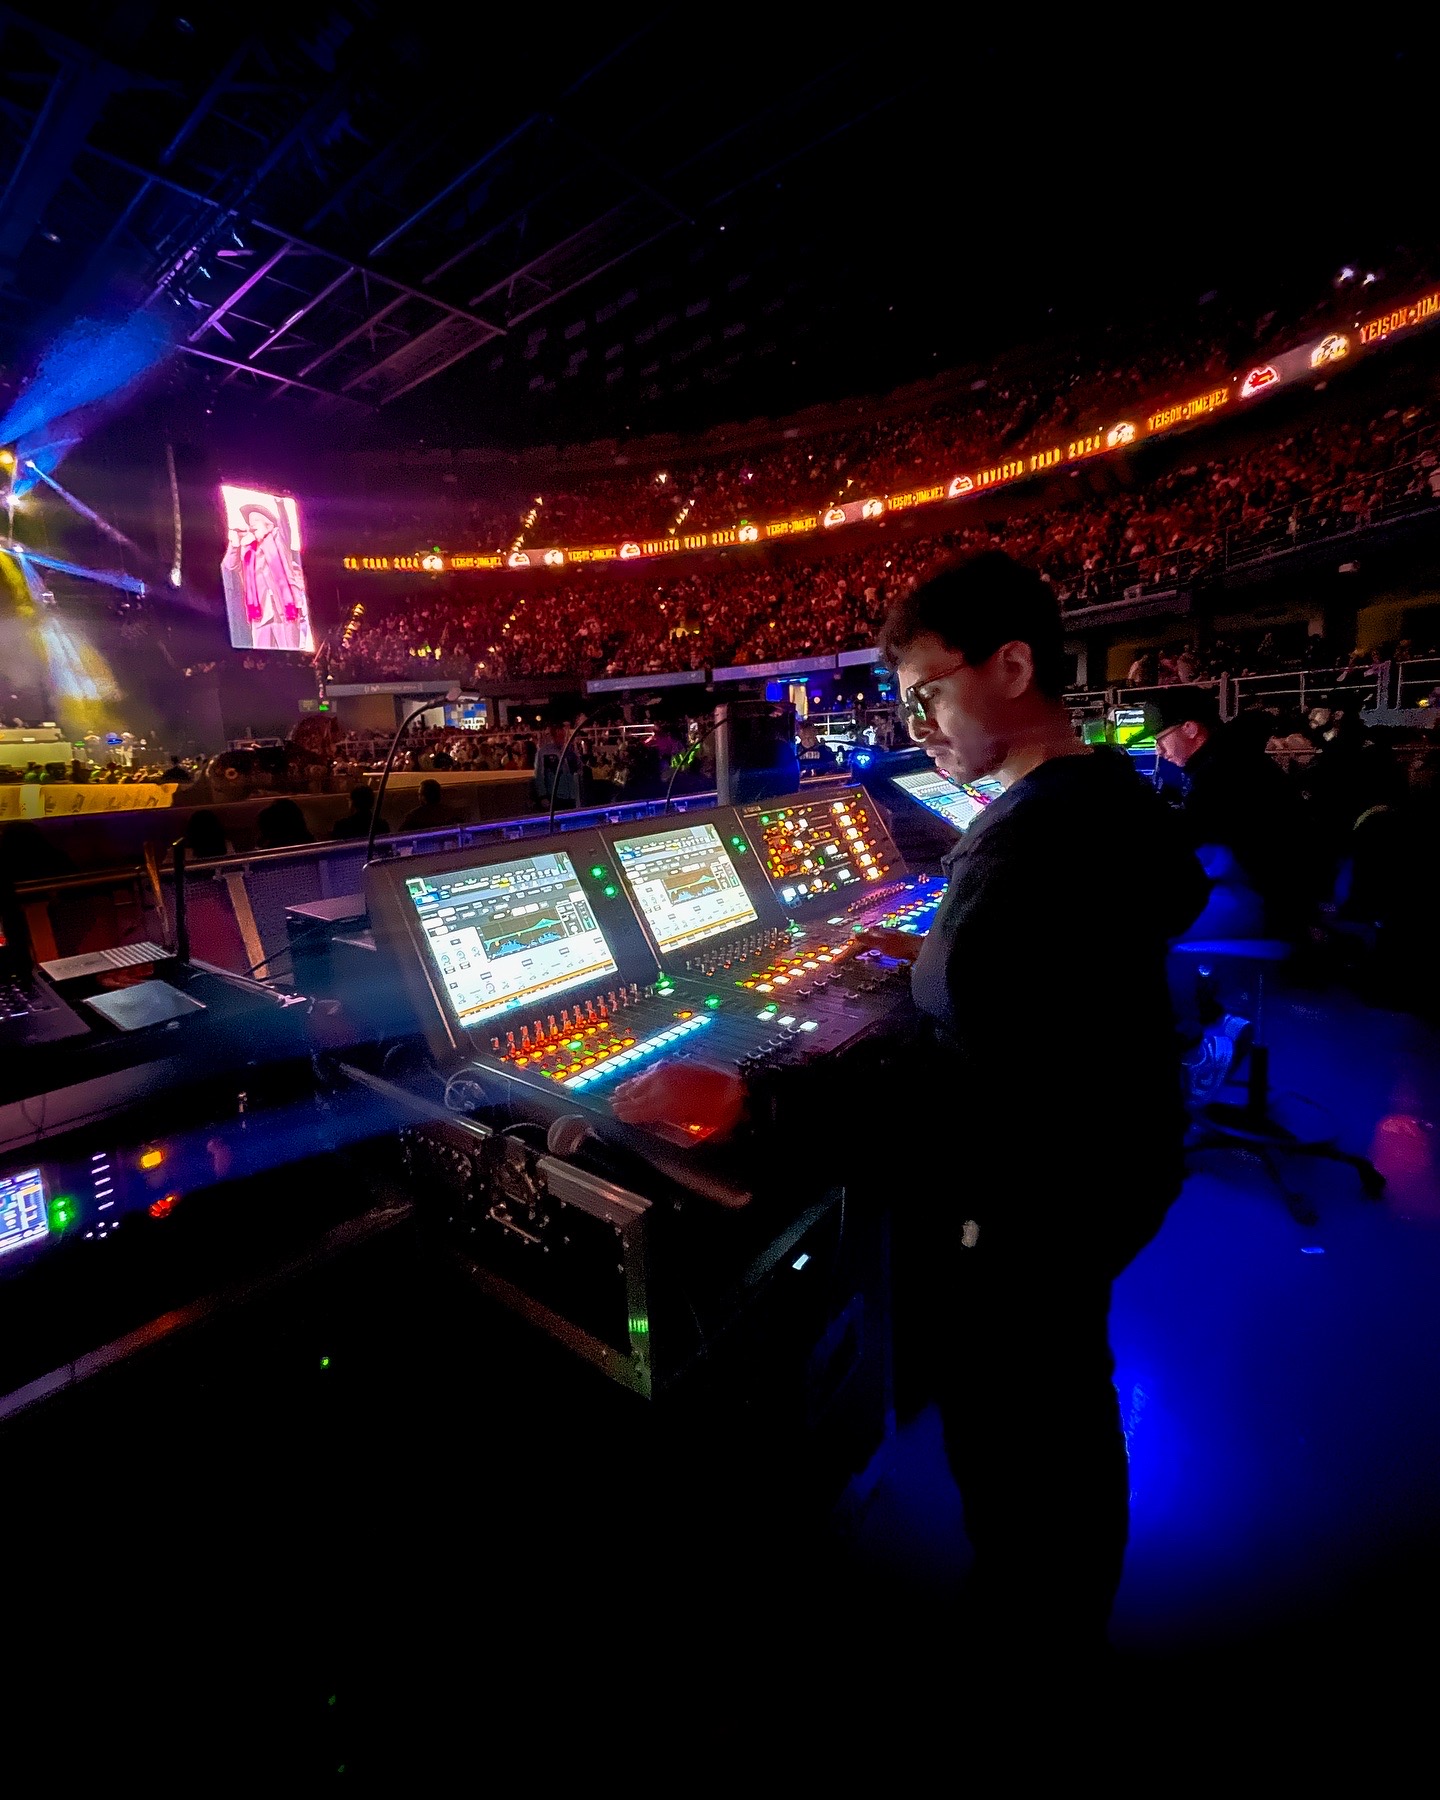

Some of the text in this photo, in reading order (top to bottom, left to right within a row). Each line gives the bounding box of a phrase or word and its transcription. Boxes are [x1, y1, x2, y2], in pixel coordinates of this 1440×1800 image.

[1360, 291, 1440, 345] YEISON JIM
[1148, 406, 1182, 431] YEISON
[1068, 434, 1101, 460] 2024
